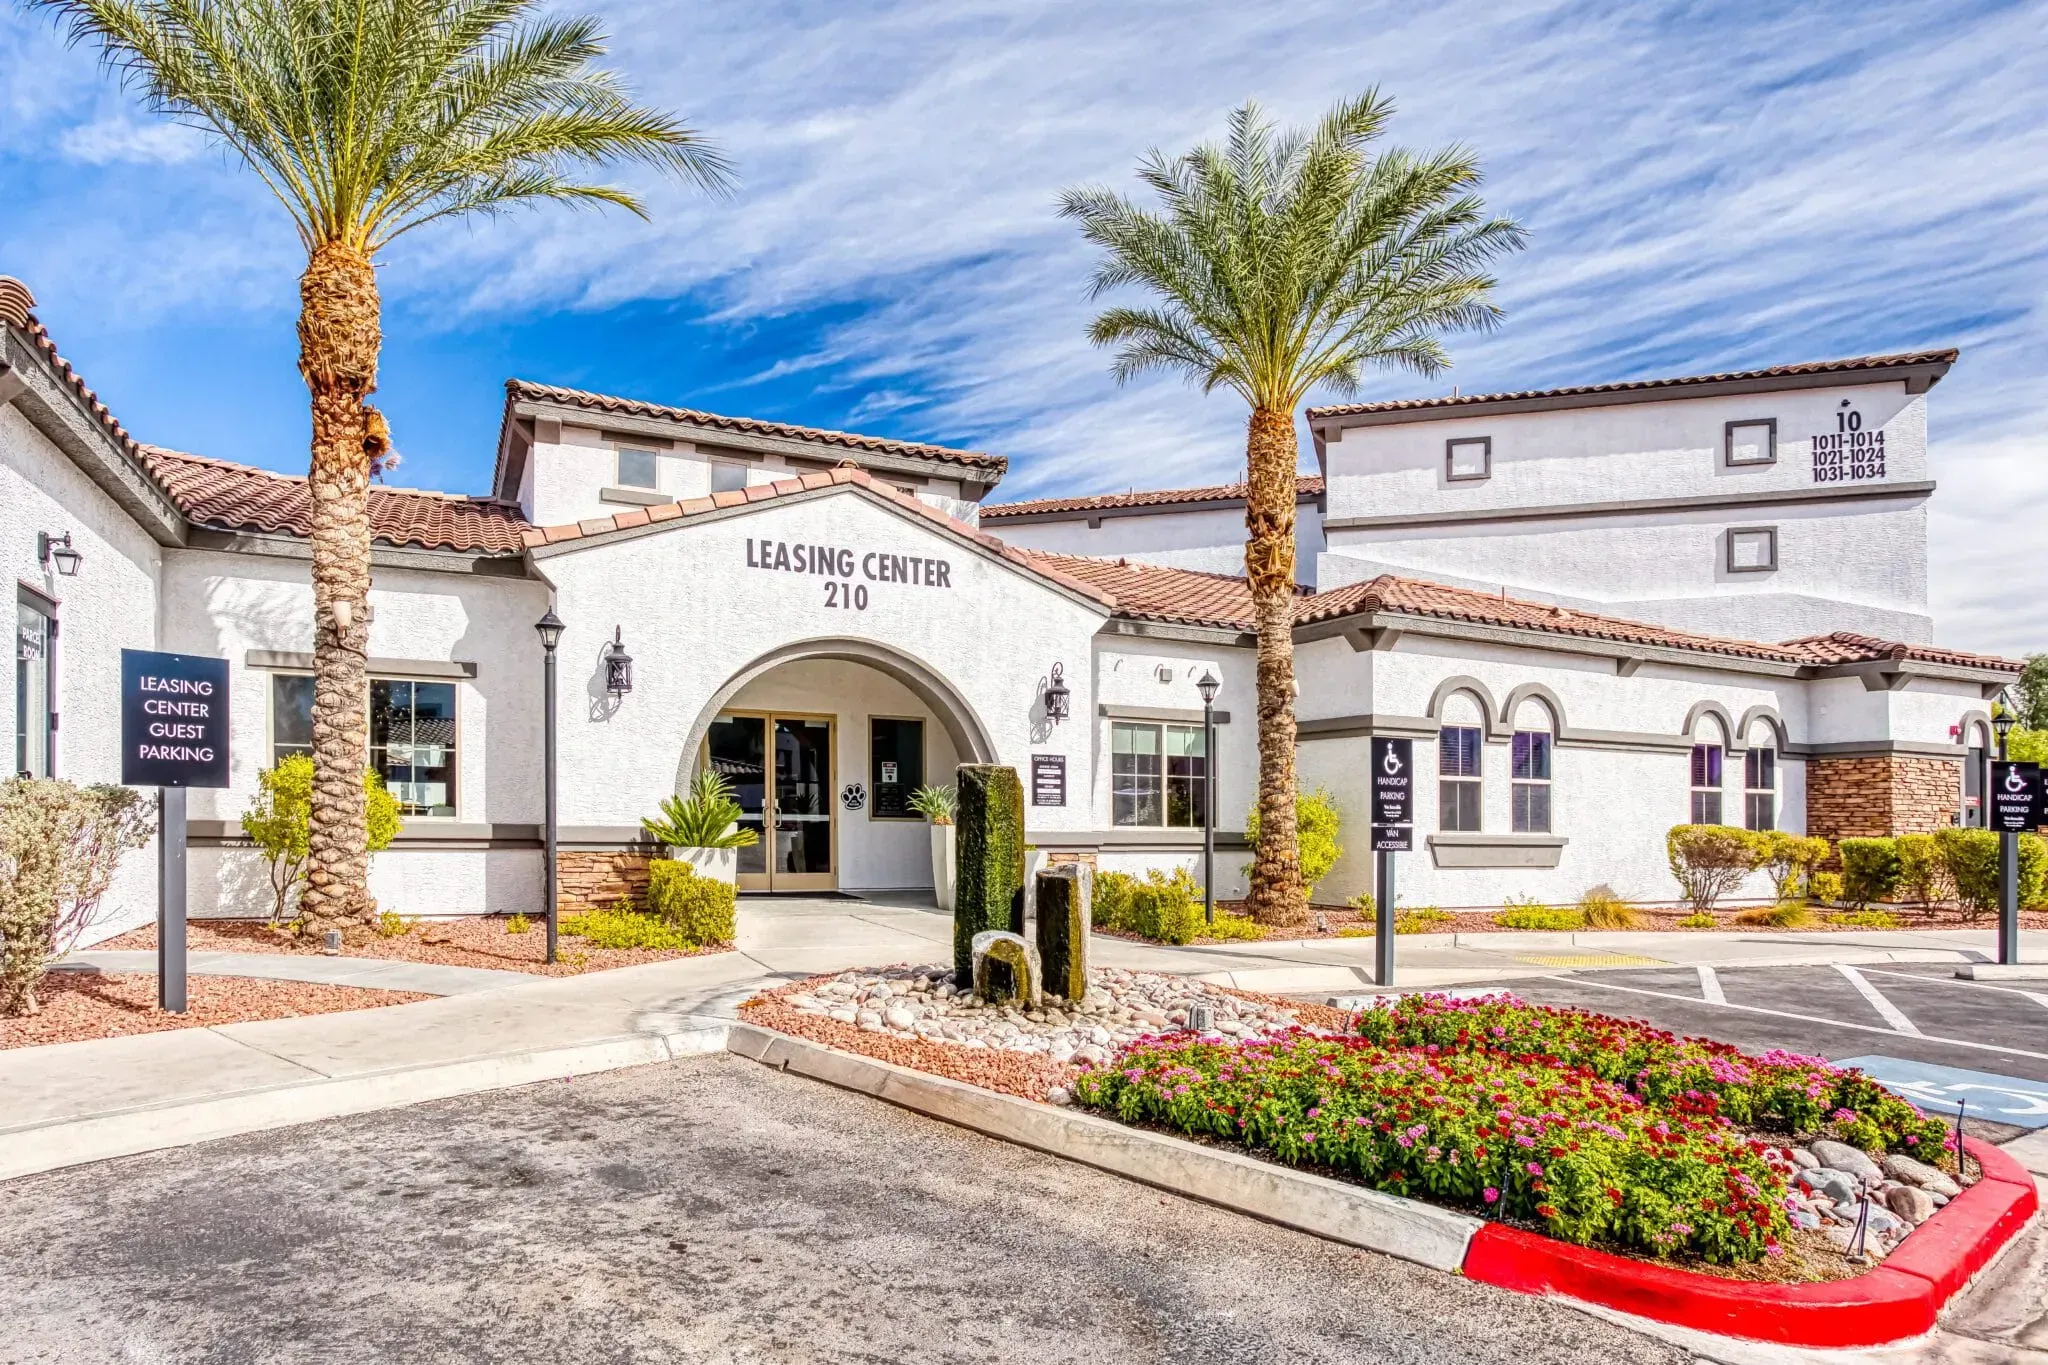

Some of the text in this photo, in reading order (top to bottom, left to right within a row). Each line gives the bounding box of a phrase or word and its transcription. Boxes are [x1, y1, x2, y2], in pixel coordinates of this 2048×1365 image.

[1836, 411, 1862, 432] 10
[1811, 430, 1885, 451] 1011-1014
[1811, 446, 1886, 467] 1021-1024
[1812, 462, 1887, 482] 1031-1034
[746, 538, 952, 588] LEASING CENTER
[823, 581, 869, 611] 210
[140, 676, 213, 696] LEASING
[144, 699, 209, 718] CENTER
[149, 722, 205, 739] GUEST
[139, 744, 214, 762] PARKING
[1377, 776, 1408, 786] HANDICAP
[1380, 791, 1405, 801] PARKING
[1996, 793, 2033, 802] HANDICAP
[1999, 805, 2030, 814] PARKING
[1386, 829, 1399, 838] VAN
[1376, 841, 1409, 850] ACCESSIBLE
